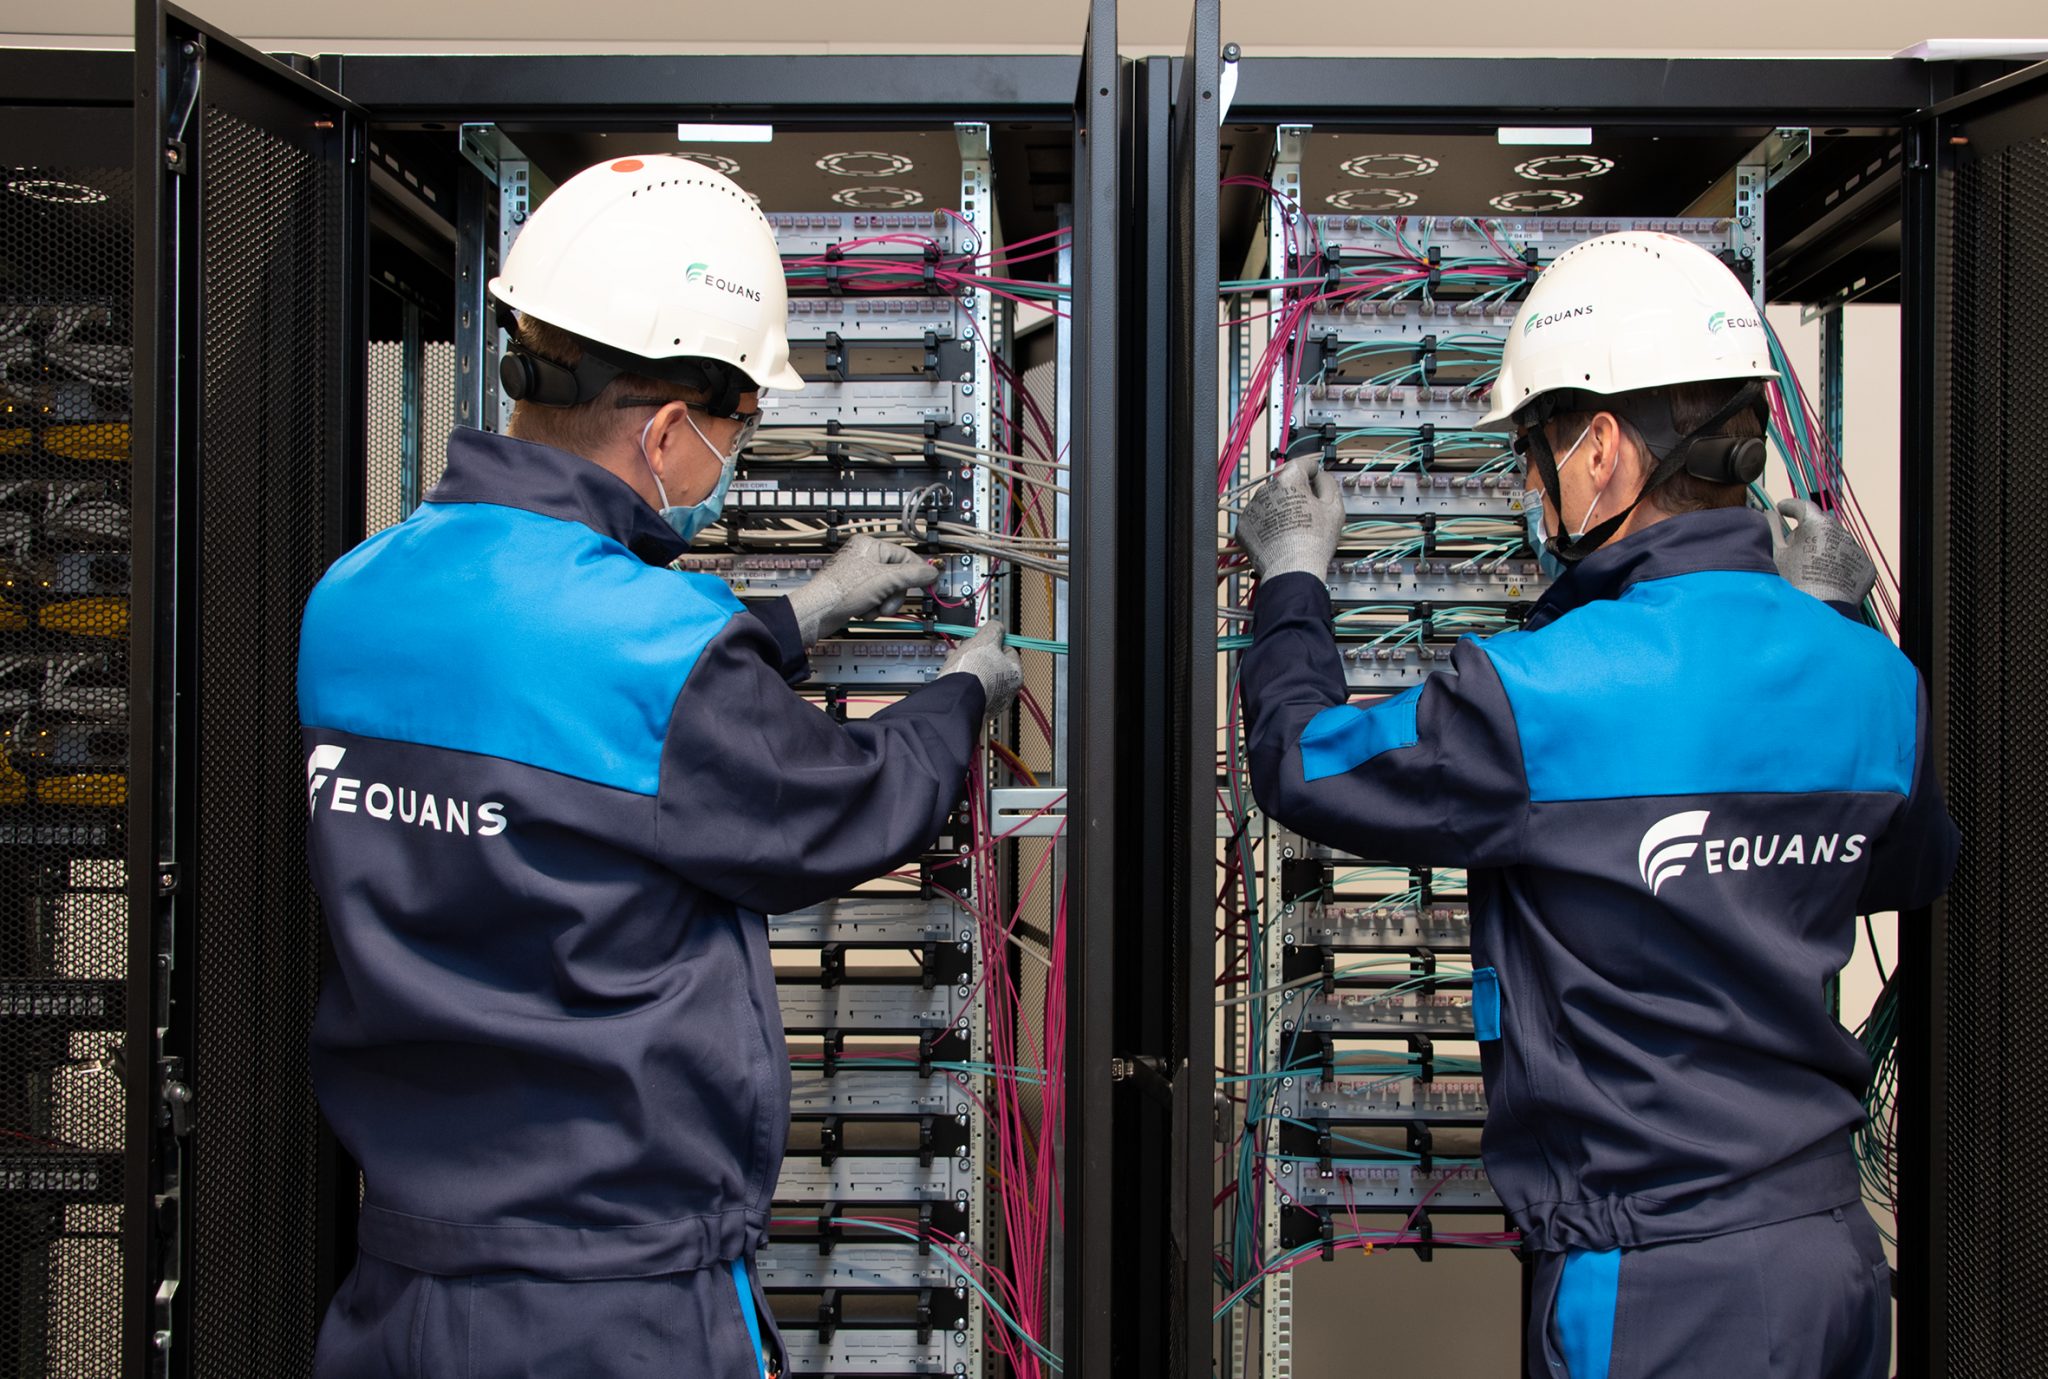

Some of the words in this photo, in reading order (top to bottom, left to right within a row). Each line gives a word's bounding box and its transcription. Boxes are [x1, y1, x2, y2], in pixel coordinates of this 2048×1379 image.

[704, 274, 761, 302] EQUANS
[1536, 304, 1593, 329] EQUANS
[330, 777, 507, 836] EQUANS
[1705, 833, 1867, 874] EQUANS
